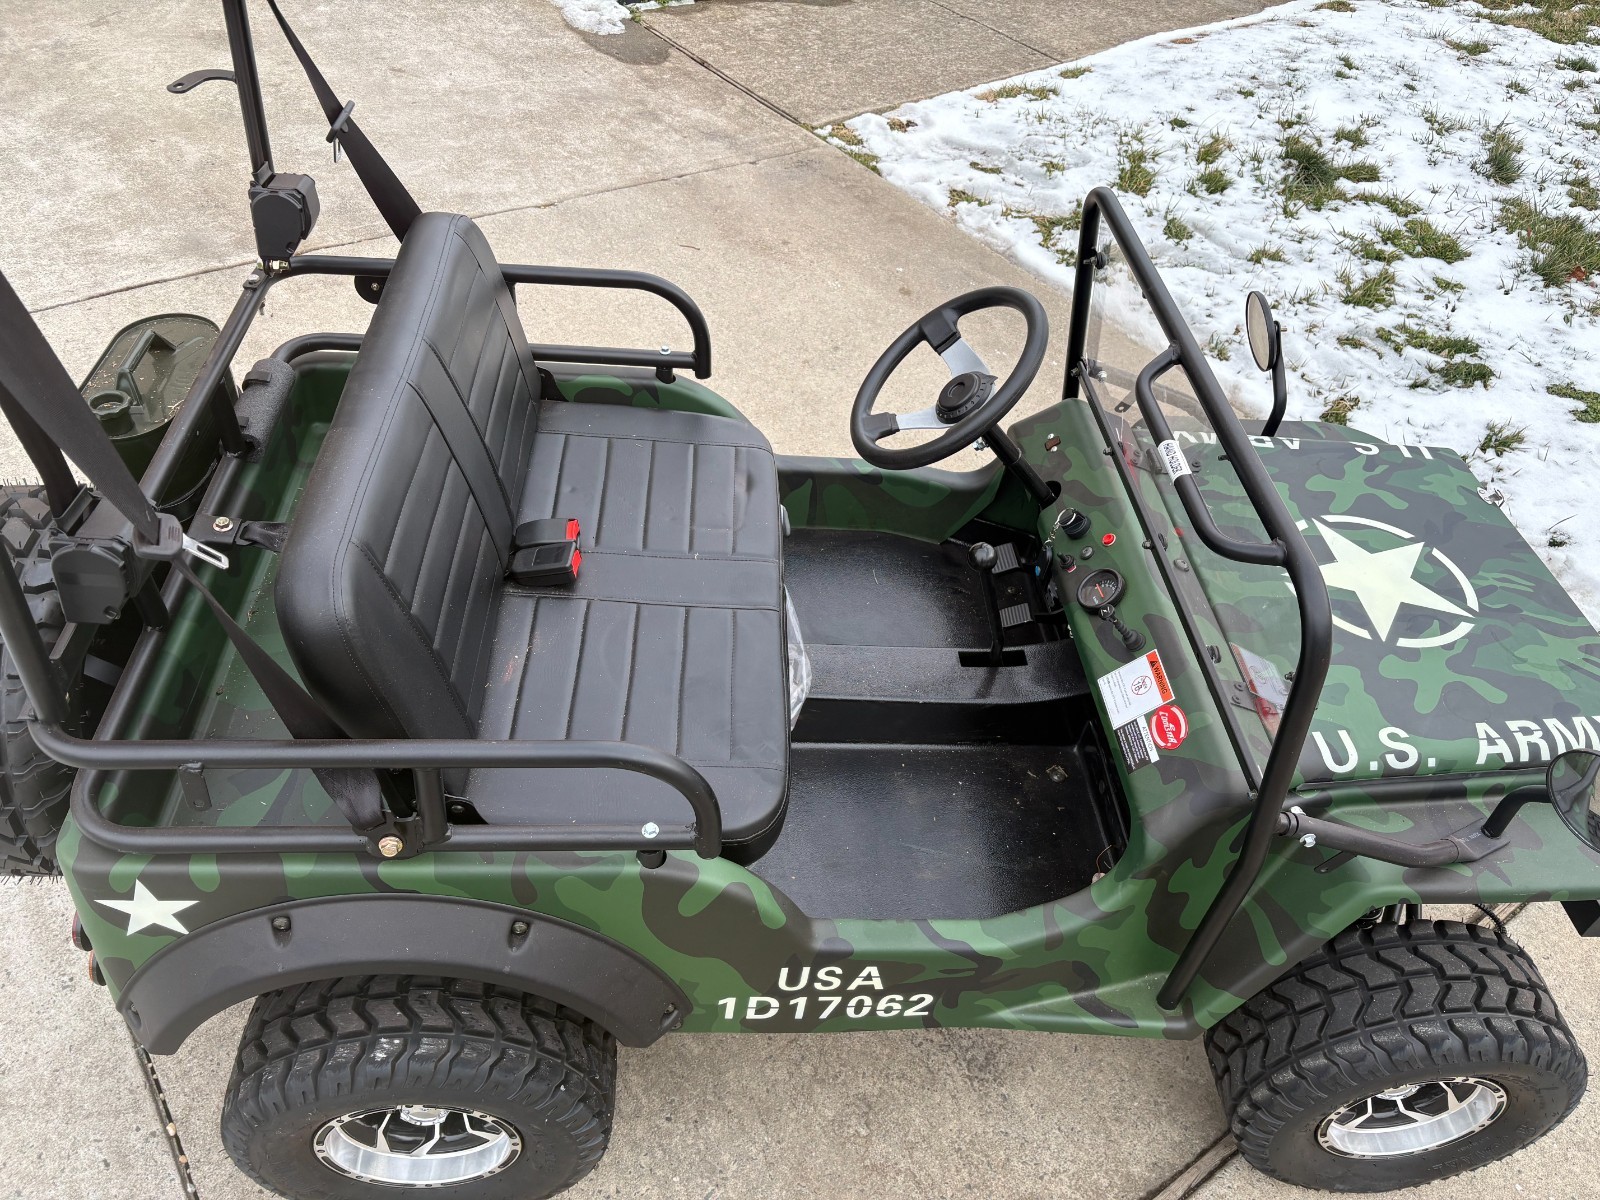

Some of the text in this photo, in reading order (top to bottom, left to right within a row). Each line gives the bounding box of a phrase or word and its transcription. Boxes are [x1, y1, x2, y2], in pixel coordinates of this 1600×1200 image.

[1163, 443, 1176, 457] HAND
[1154, 665, 1168, 695] WARNING
[1142, 726, 1155, 752] ATTENTION
[1311, 715, 1600, 773] U.S. ARM
[777, 966, 884, 991] USA
[717, 993, 934, 1020] 1D17062
